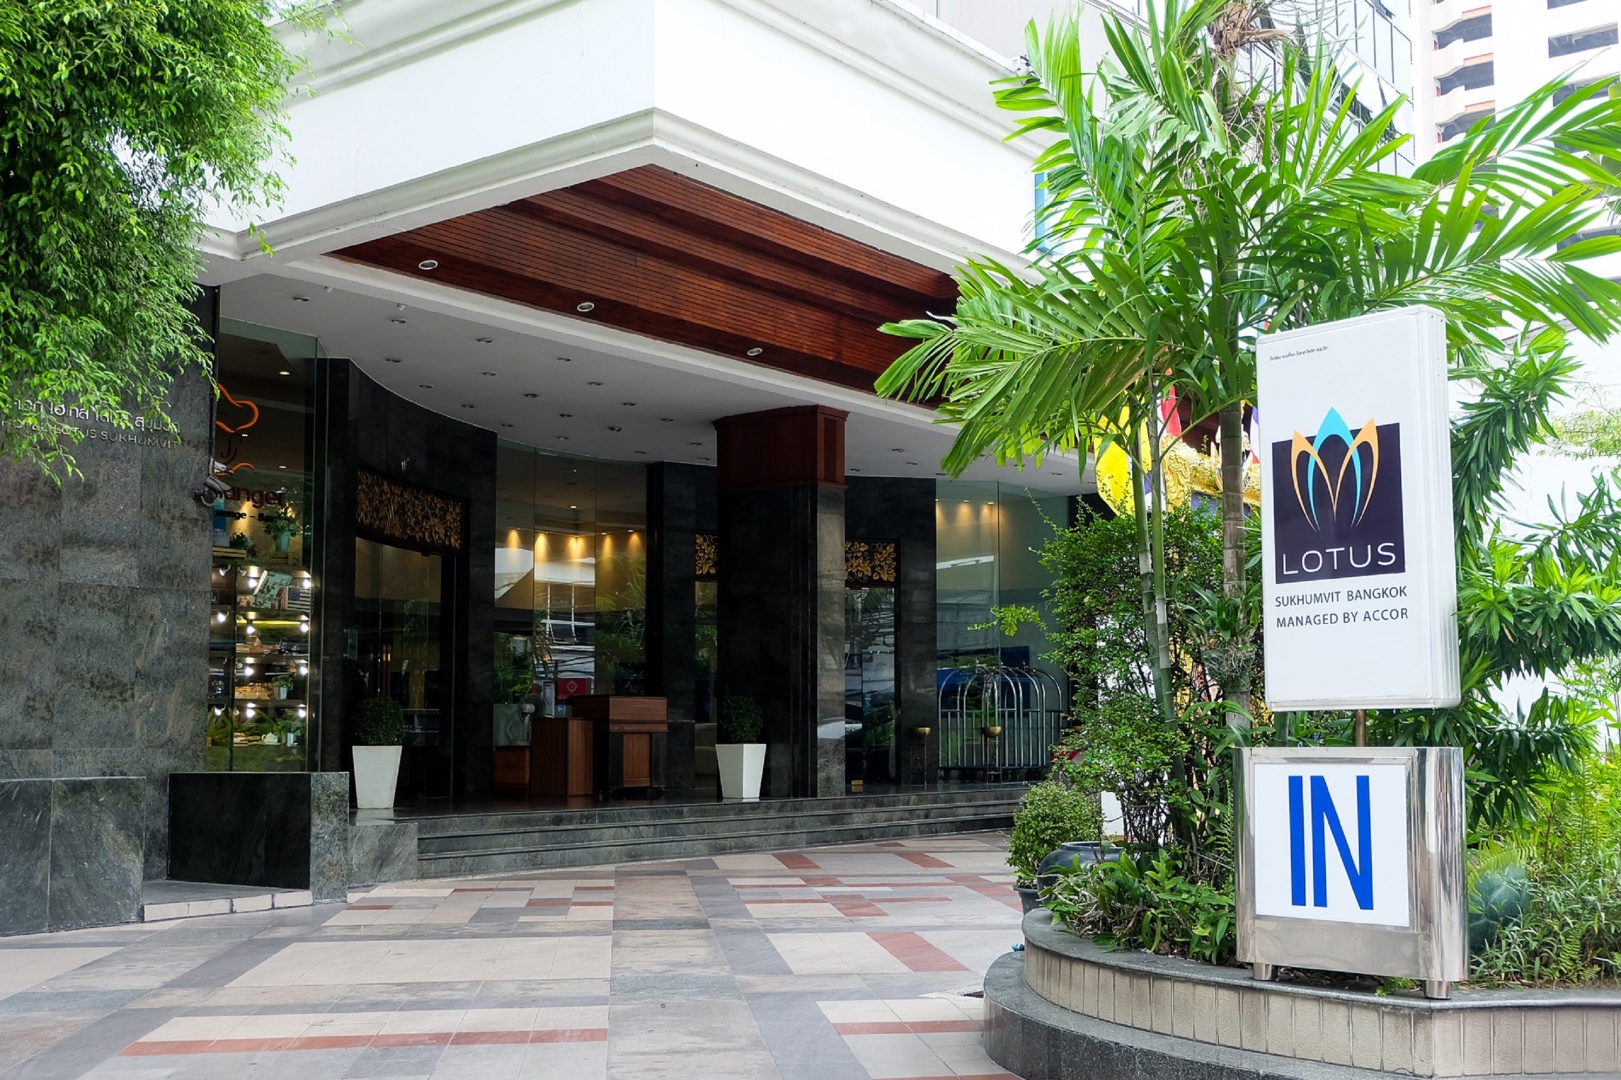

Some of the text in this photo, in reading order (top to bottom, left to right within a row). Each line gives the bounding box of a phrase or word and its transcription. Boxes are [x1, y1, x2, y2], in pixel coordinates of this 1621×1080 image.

[100, 428, 179, 449] SUKHUMVIT
[1282, 542, 1396, 575] LOTUS
[1275, 585, 1407, 607] SUKHUMVIT BANGKOK
[1276, 607, 1408, 628] MANAGED BY ACCOR
[1288, 775, 1374, 911] IN
